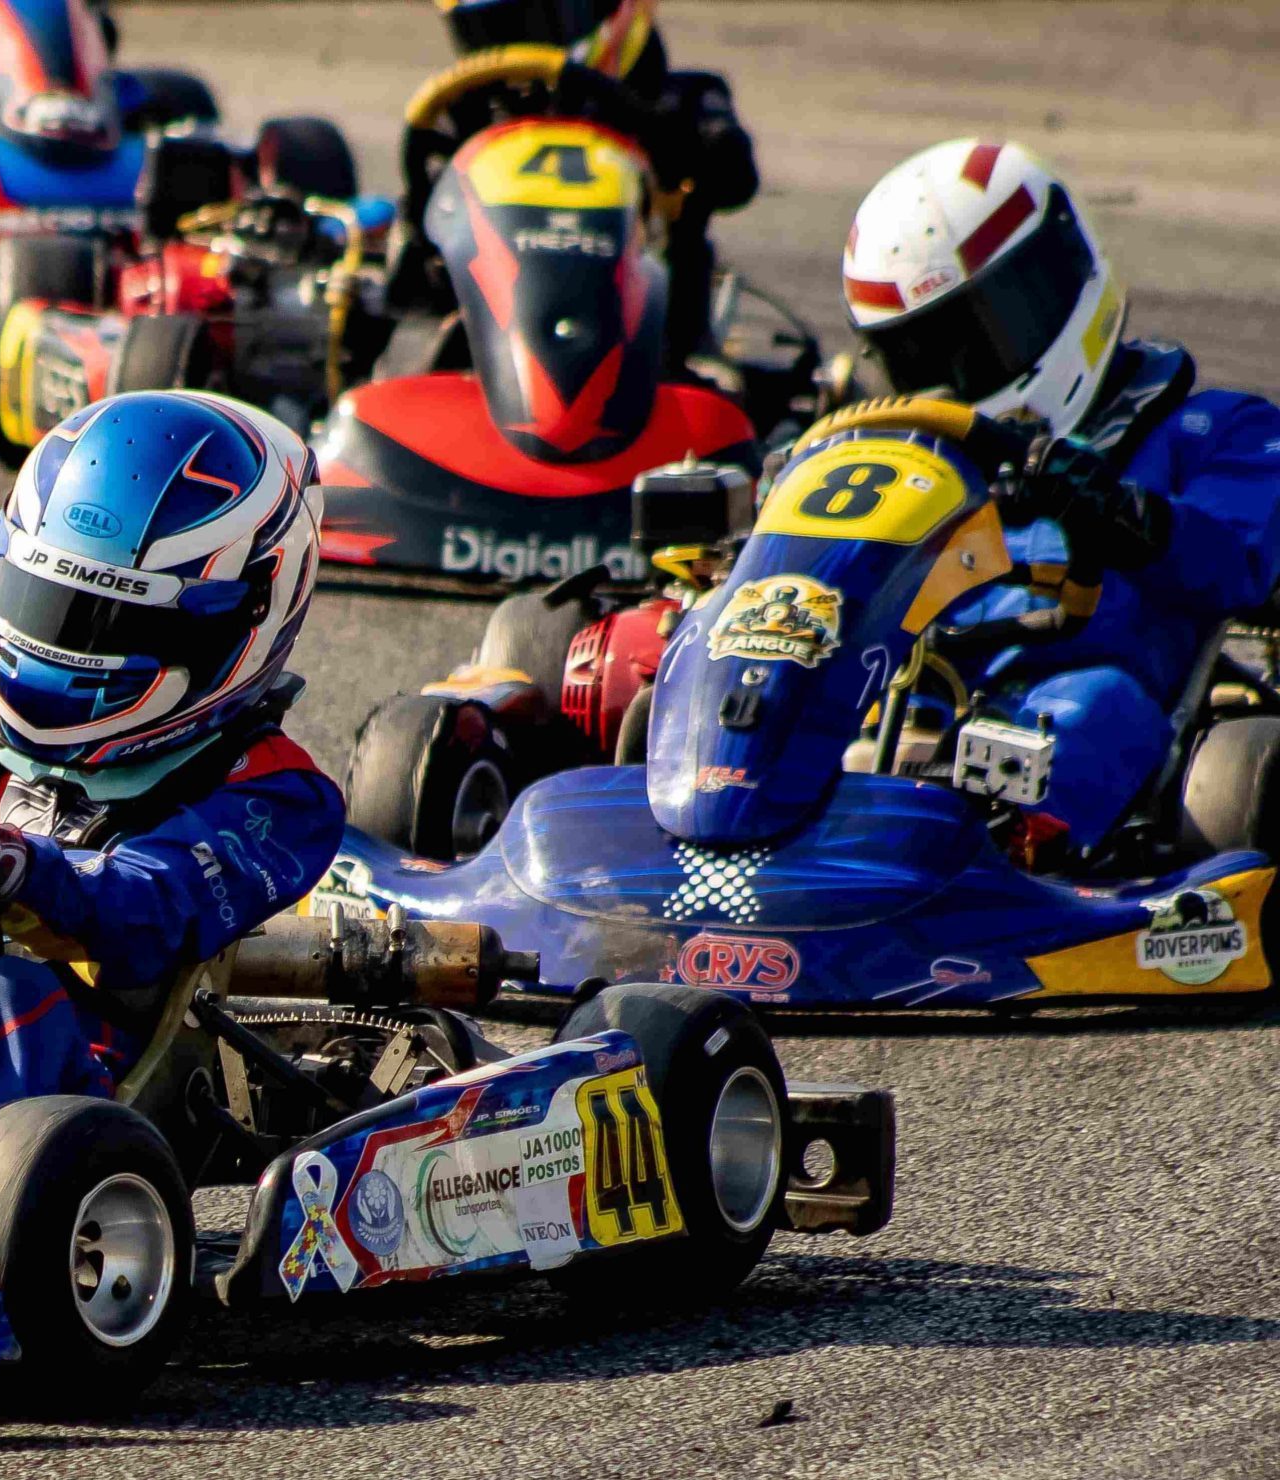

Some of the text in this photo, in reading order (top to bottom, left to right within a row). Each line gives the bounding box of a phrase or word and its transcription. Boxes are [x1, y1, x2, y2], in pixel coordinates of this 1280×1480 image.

[521, 145, 595, 182] 4
[800, 463, 897, 520] 8
[69, 507, 111, 531] BELL
[23, 549, 150, 596] JP SIMÕES
[685, 943, 790, 985] CRYS
[523, 1127, 581, 1160] JA1000
[588, 1088, 669, 1235] 44
[527, 1155, 580, 1183] POSTOS
[522, 1222, 571, 1242] NEON
